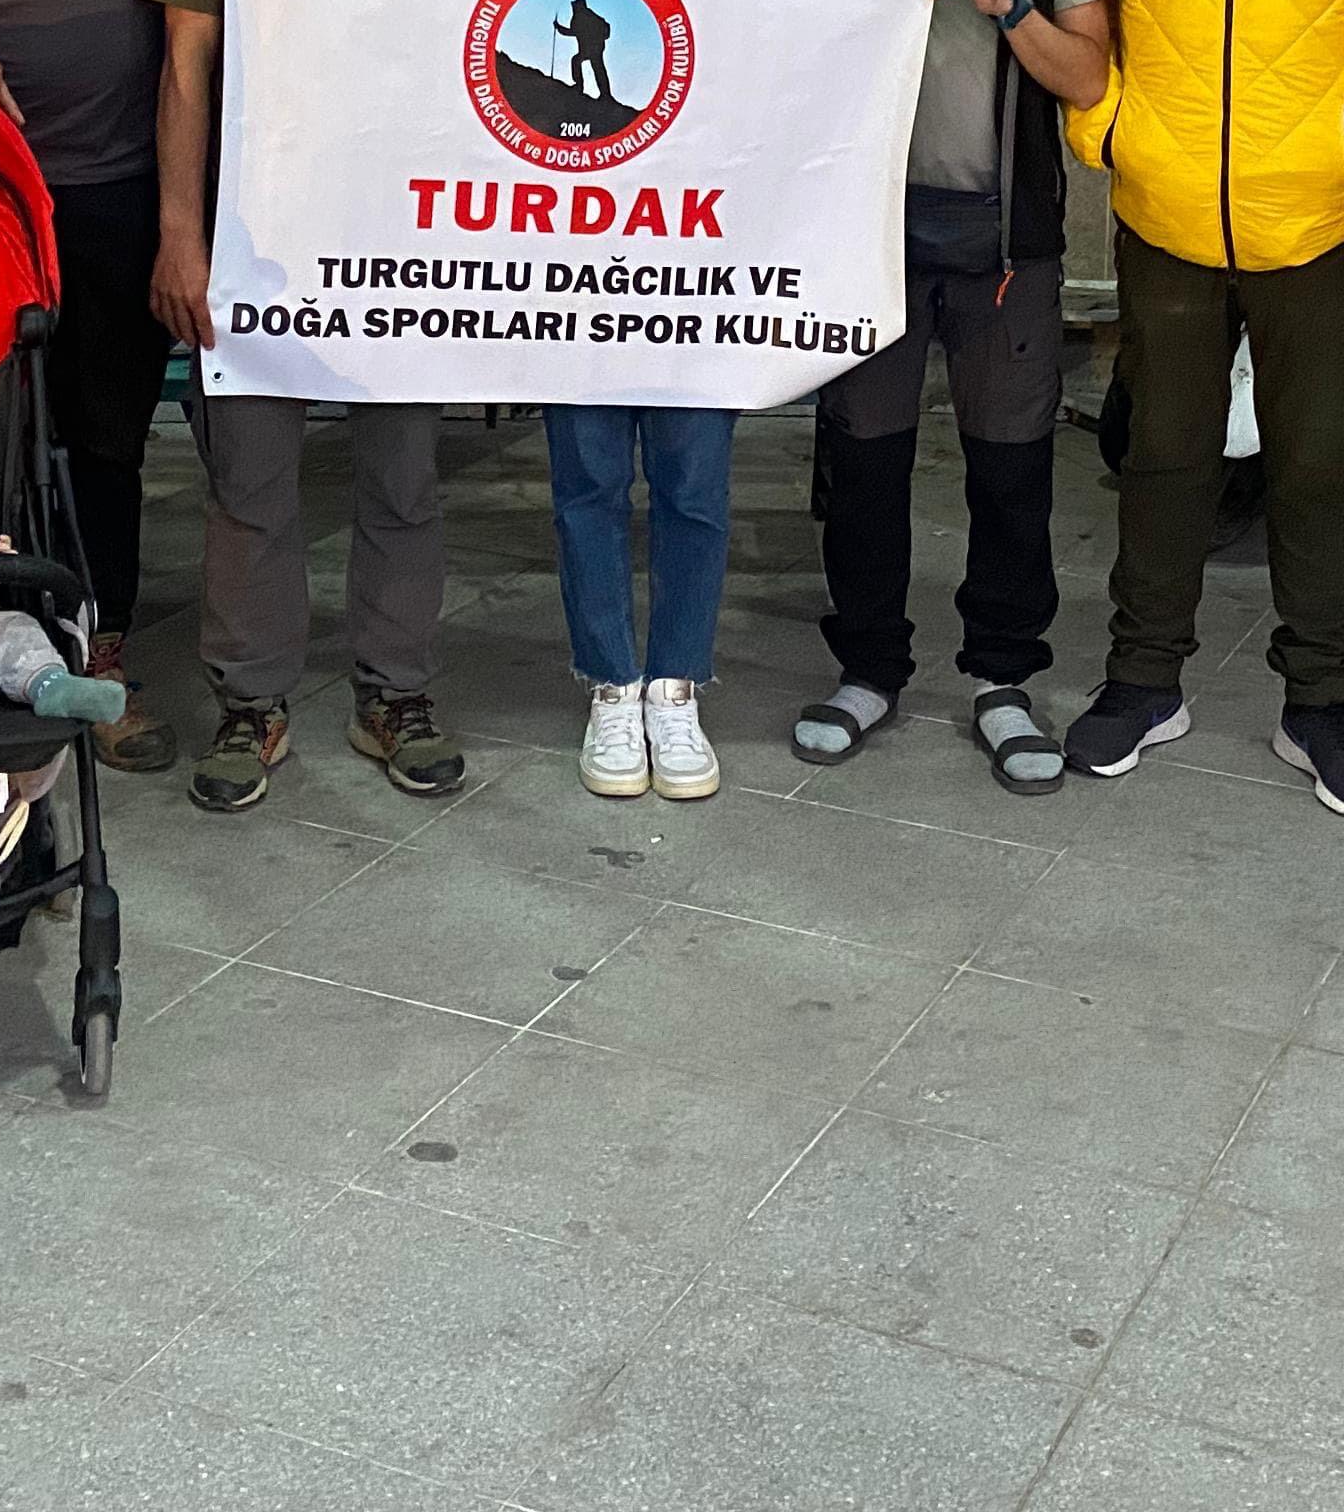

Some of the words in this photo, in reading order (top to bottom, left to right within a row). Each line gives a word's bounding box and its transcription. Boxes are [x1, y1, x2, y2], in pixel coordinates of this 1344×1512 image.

[470, 0, 502, 81] TURGUTLU
[662, 13, 690, 78] KULÜBÜ
[474, 84, 527, 149] DAĞCILIK
[655, 81, 685, 120] SPOR
[524, 145, 541, 160] ve
[560, 122, 591, 137] 2004
[594, 118, 662, 165] SPORLARI
[544, 145, 591, 168] DOĞA
[409, 178, 725, 239] TURDAK
[317, 257, 532, 292] TURGUTLU
[545, 255, 736, 299] DAĞCILIK
[748, 266, 802, 300] VE
[231, 298, 351, 339] DOĞA
[362, 306, 577, 343] SPORLARI
[587, 312, 700, 345] SPOR
[714, 313, 878, 358] KULÜBÜ
